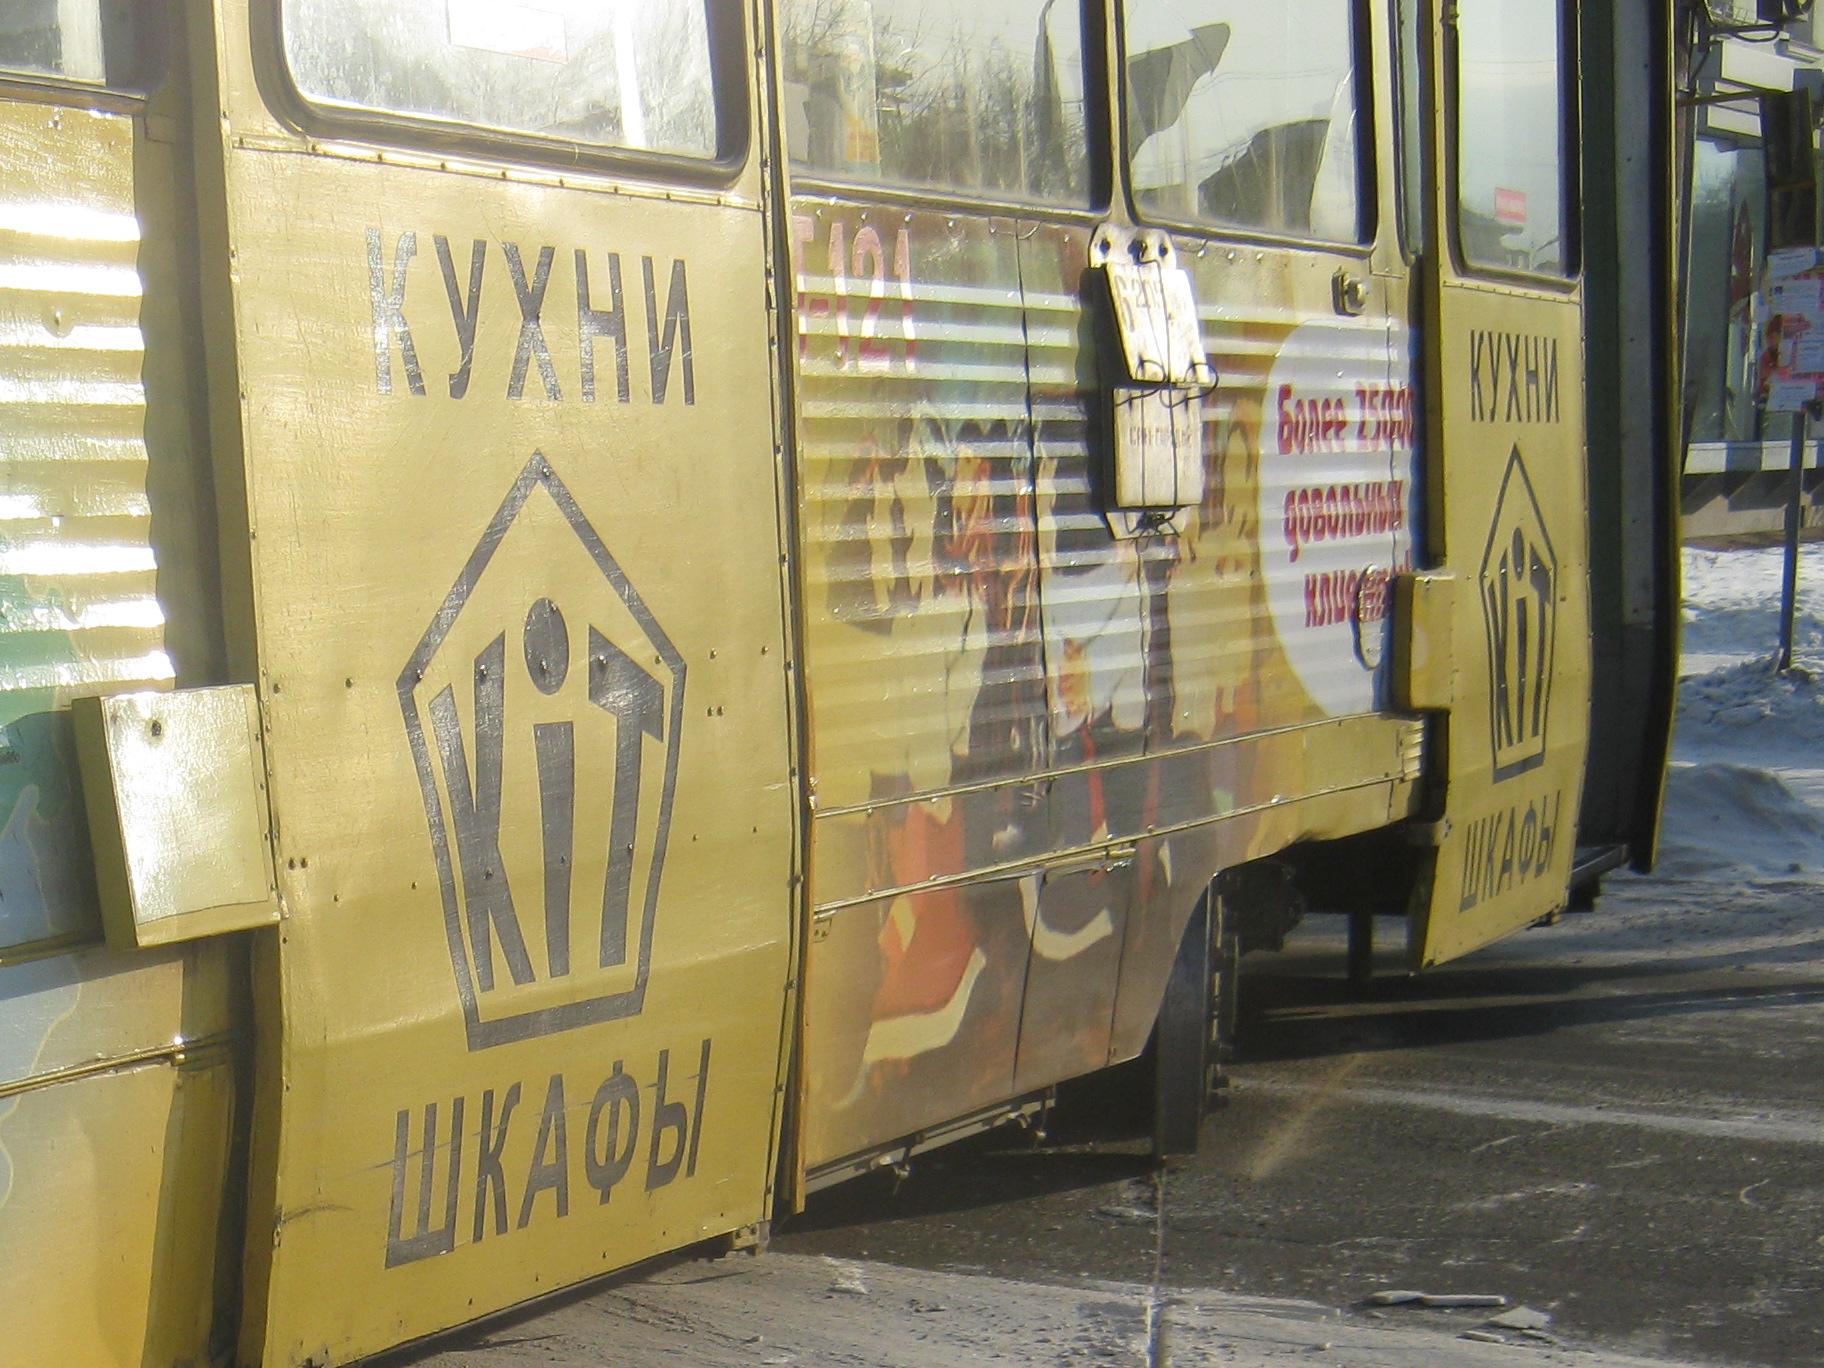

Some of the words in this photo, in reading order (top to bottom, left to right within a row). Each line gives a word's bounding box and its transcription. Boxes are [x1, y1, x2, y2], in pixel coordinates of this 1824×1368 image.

[365, 227, 695, 406] КУХНИ
[1277, 383, 1348, 456] Более
[1470, 329, 1560, 424] КУХНИ
[1283, 479, 1404, 563] довольных
[1459, 789, 1562, 913] ШКАФЫ
[384, 1038, 713, 1270] ШКАФЫ
